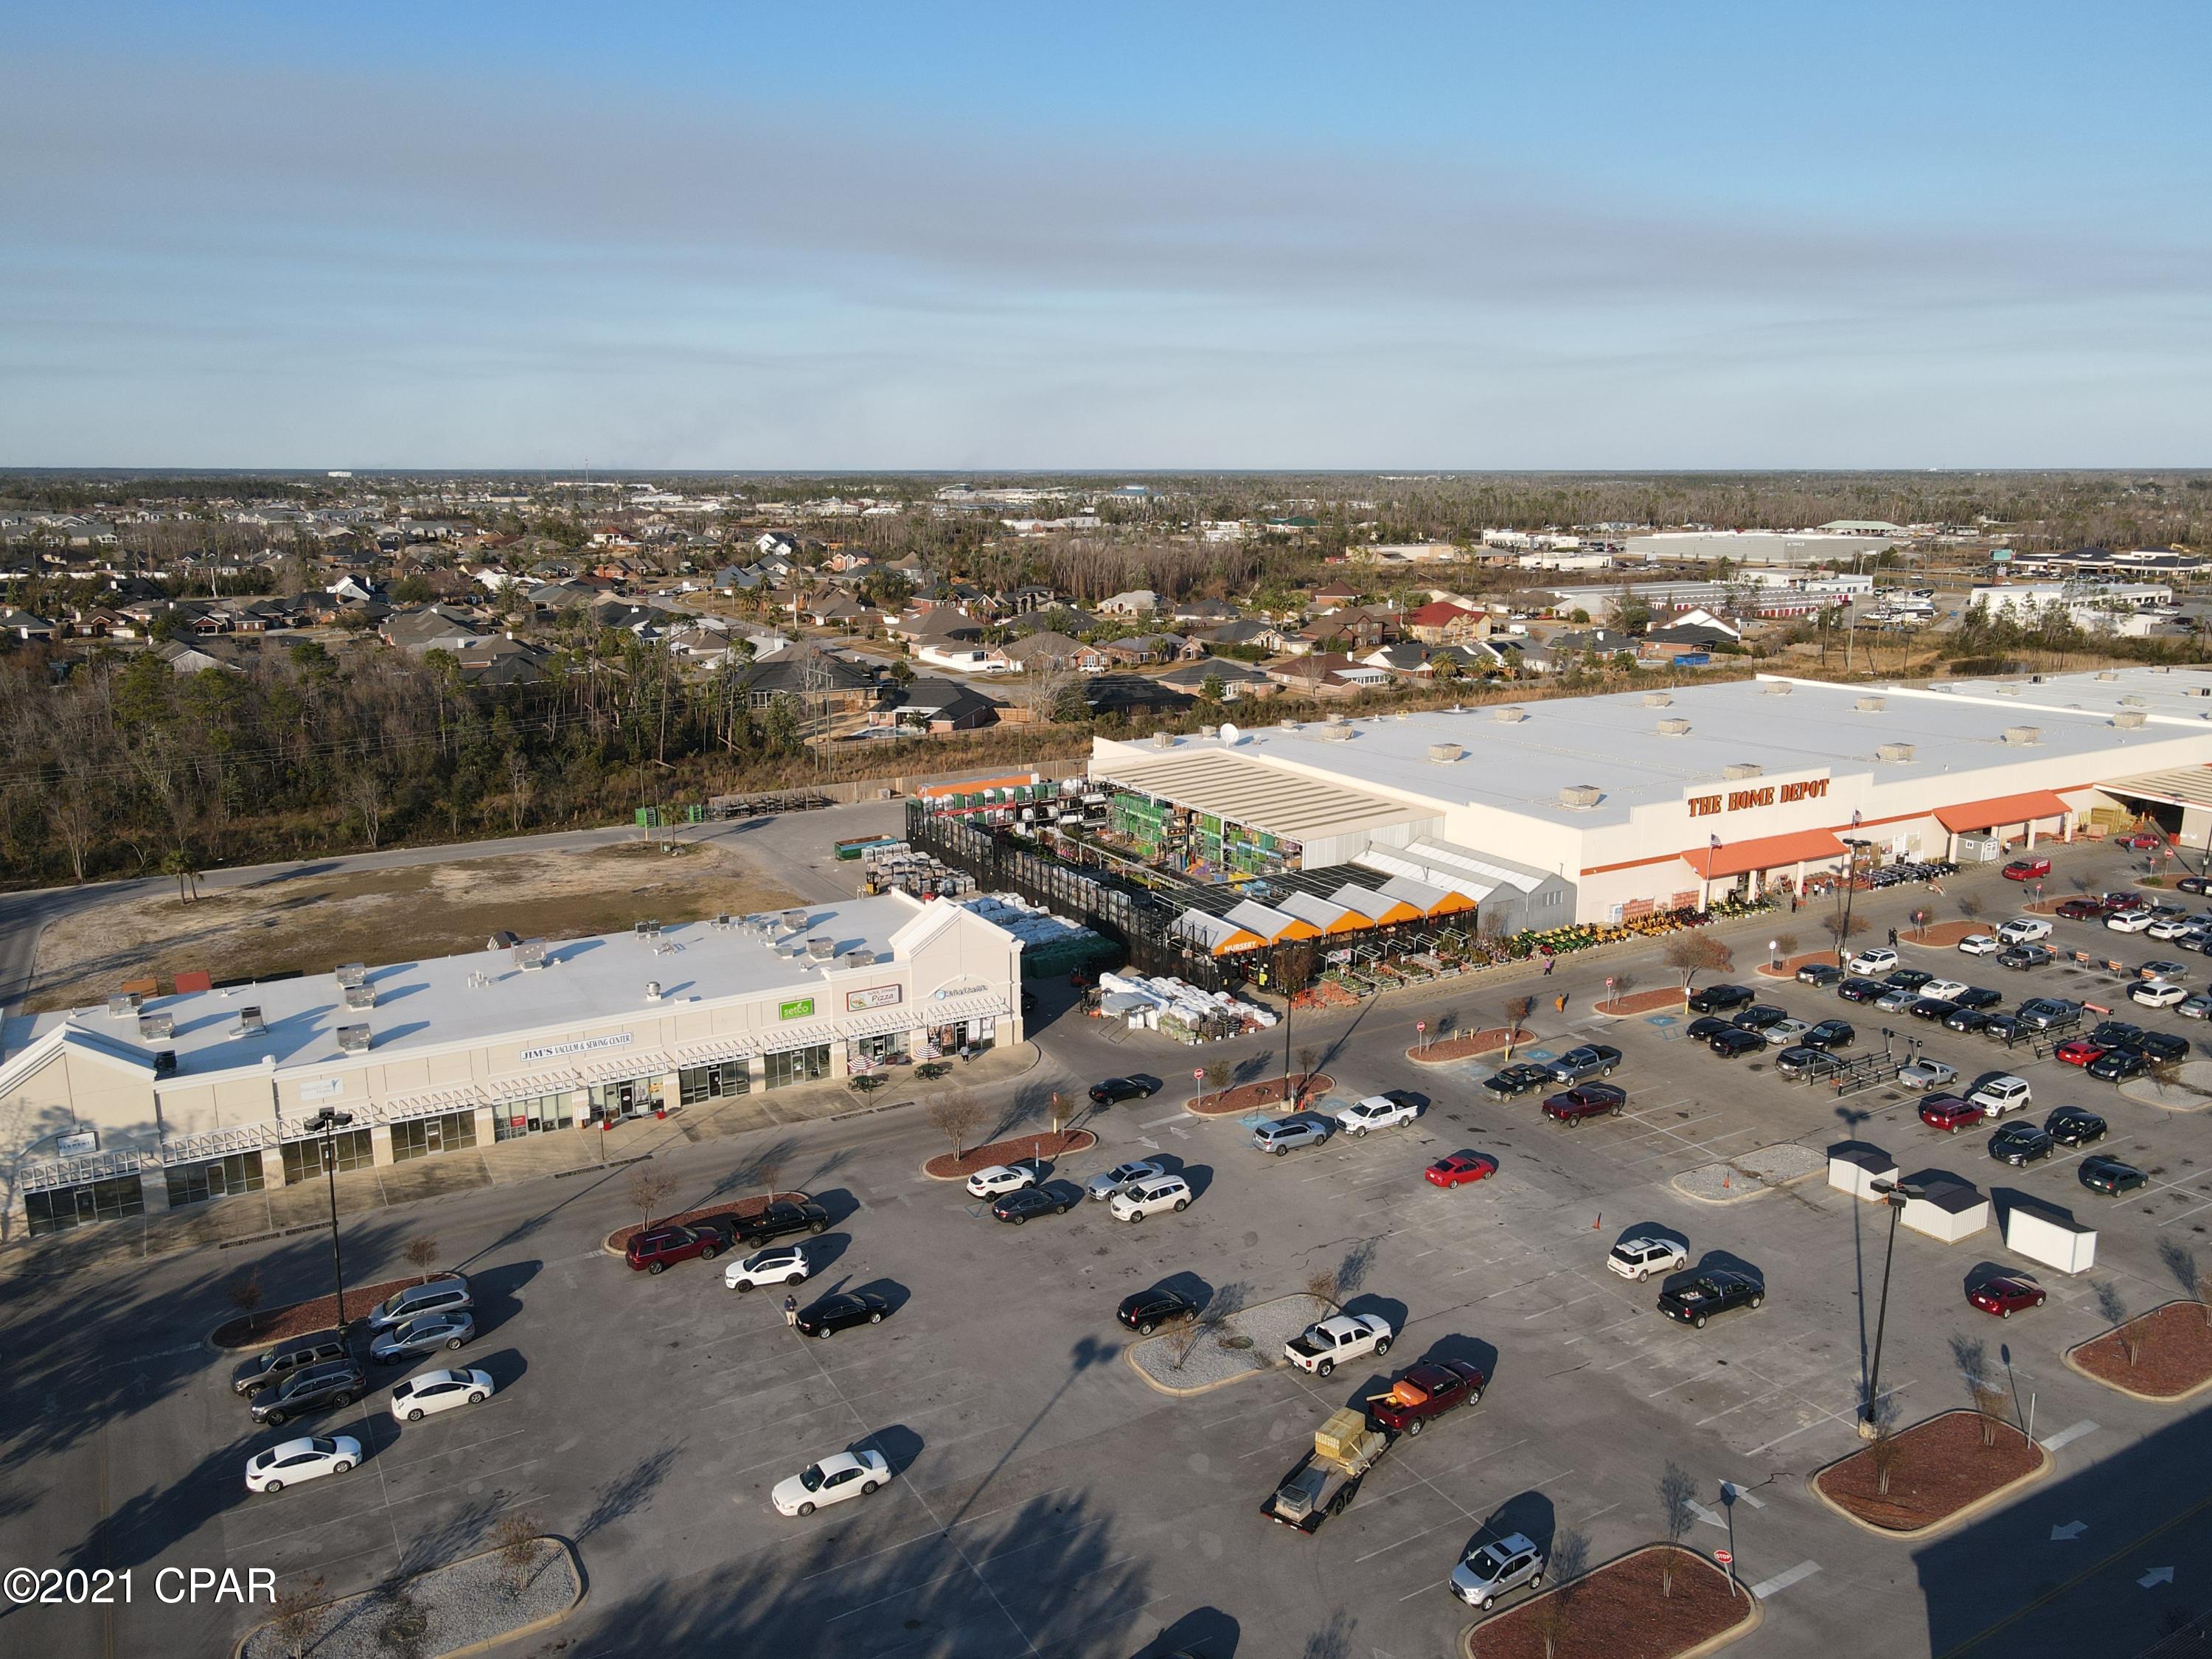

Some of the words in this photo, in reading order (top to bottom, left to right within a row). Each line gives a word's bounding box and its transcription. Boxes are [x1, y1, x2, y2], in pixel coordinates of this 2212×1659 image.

[1688, 794, 1722, 817] THE
[1727, 787, 1775, 811] HOME
[1780, 779, 1829, 803] DEPOT
[1224, 940, 1256, 953] NURSERY
[784, 1005, 809, 1016] setco
[523, 1047, 553, 1060] JIM'S
[554, 1043, 579, 1054] VACUUM
[580, 1042, 585, 1050] &
[586, 1038, 608, 1049] SEWING
[609, 1034, 630, 1045] CENTER
